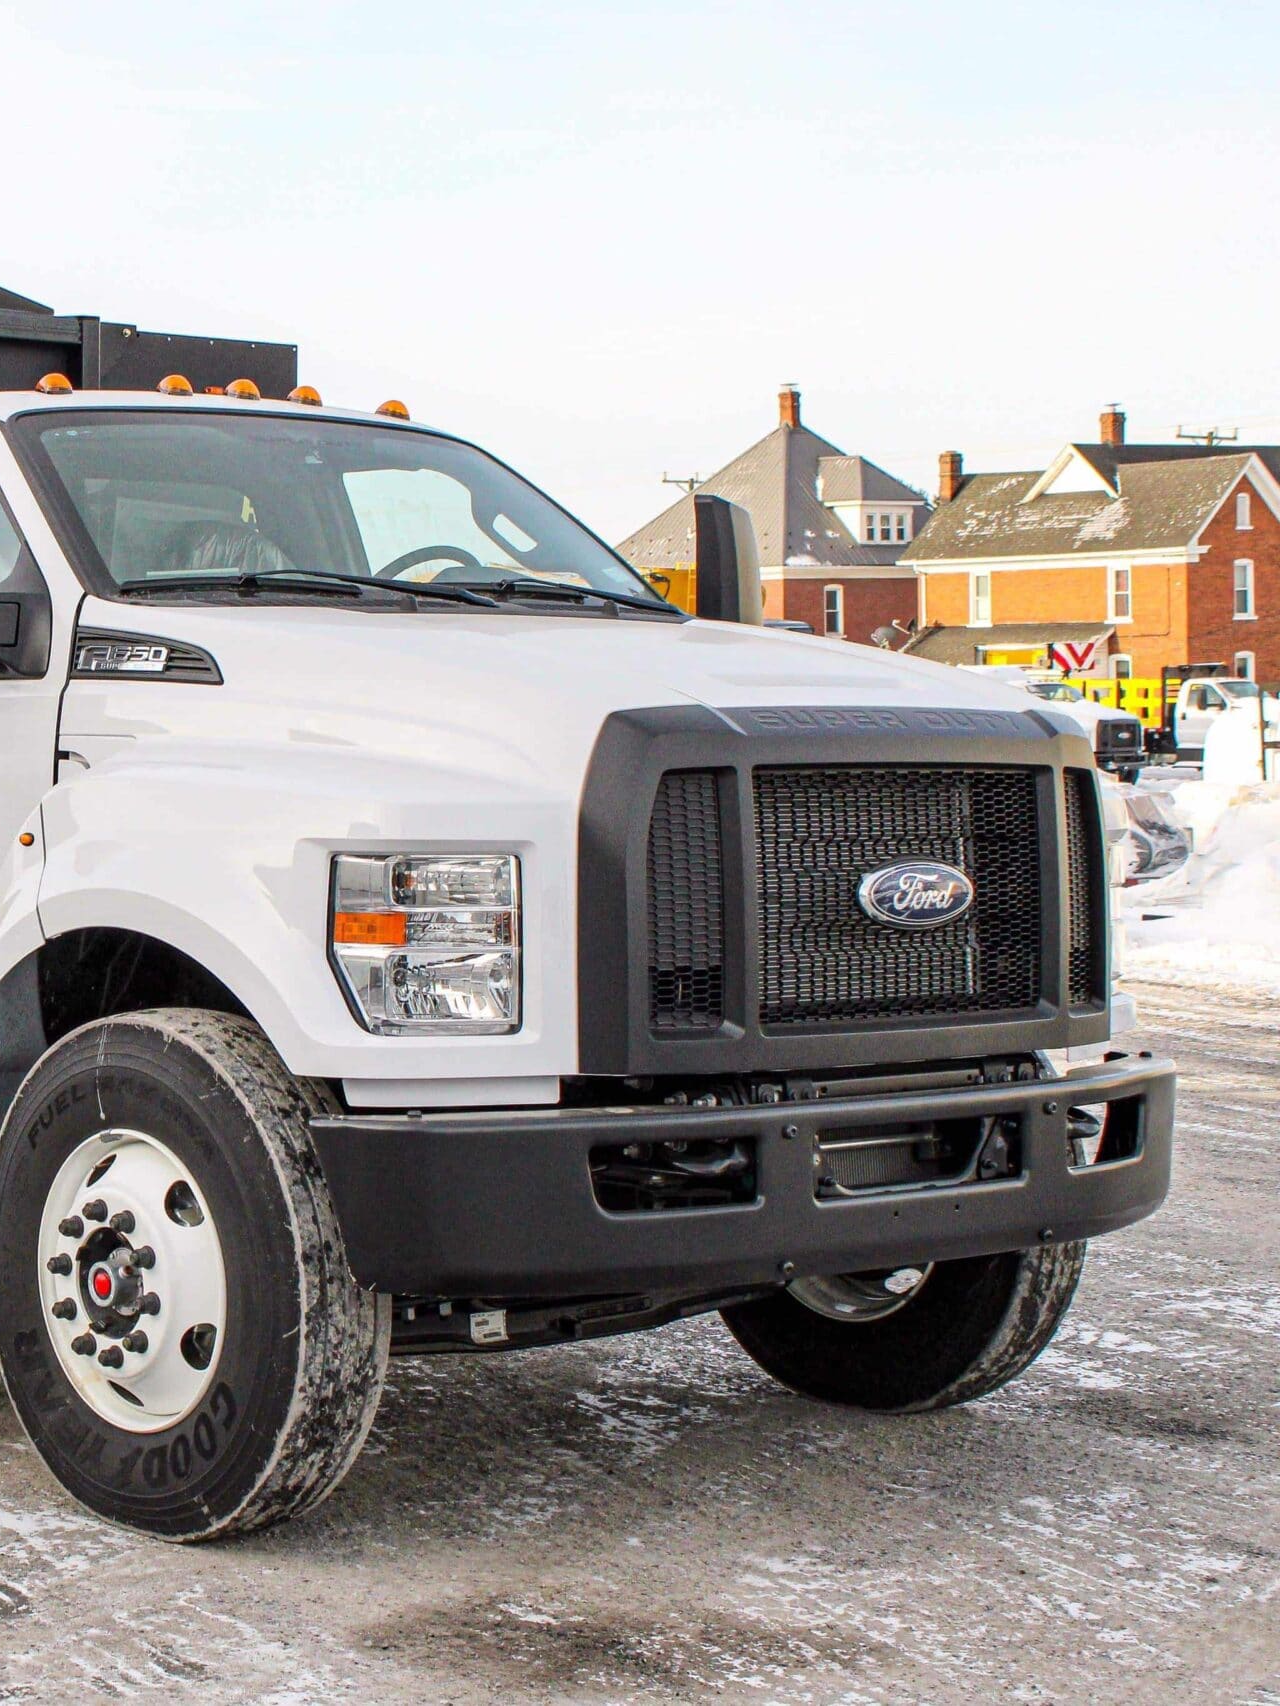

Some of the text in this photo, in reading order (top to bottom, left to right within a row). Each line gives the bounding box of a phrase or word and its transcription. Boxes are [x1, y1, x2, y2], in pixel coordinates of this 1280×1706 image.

[750, 709, 1021, 731] SUPER DUTY
[893, 873, 957, 911] Ford
[26, 1084, 87, 1151] FUEL
